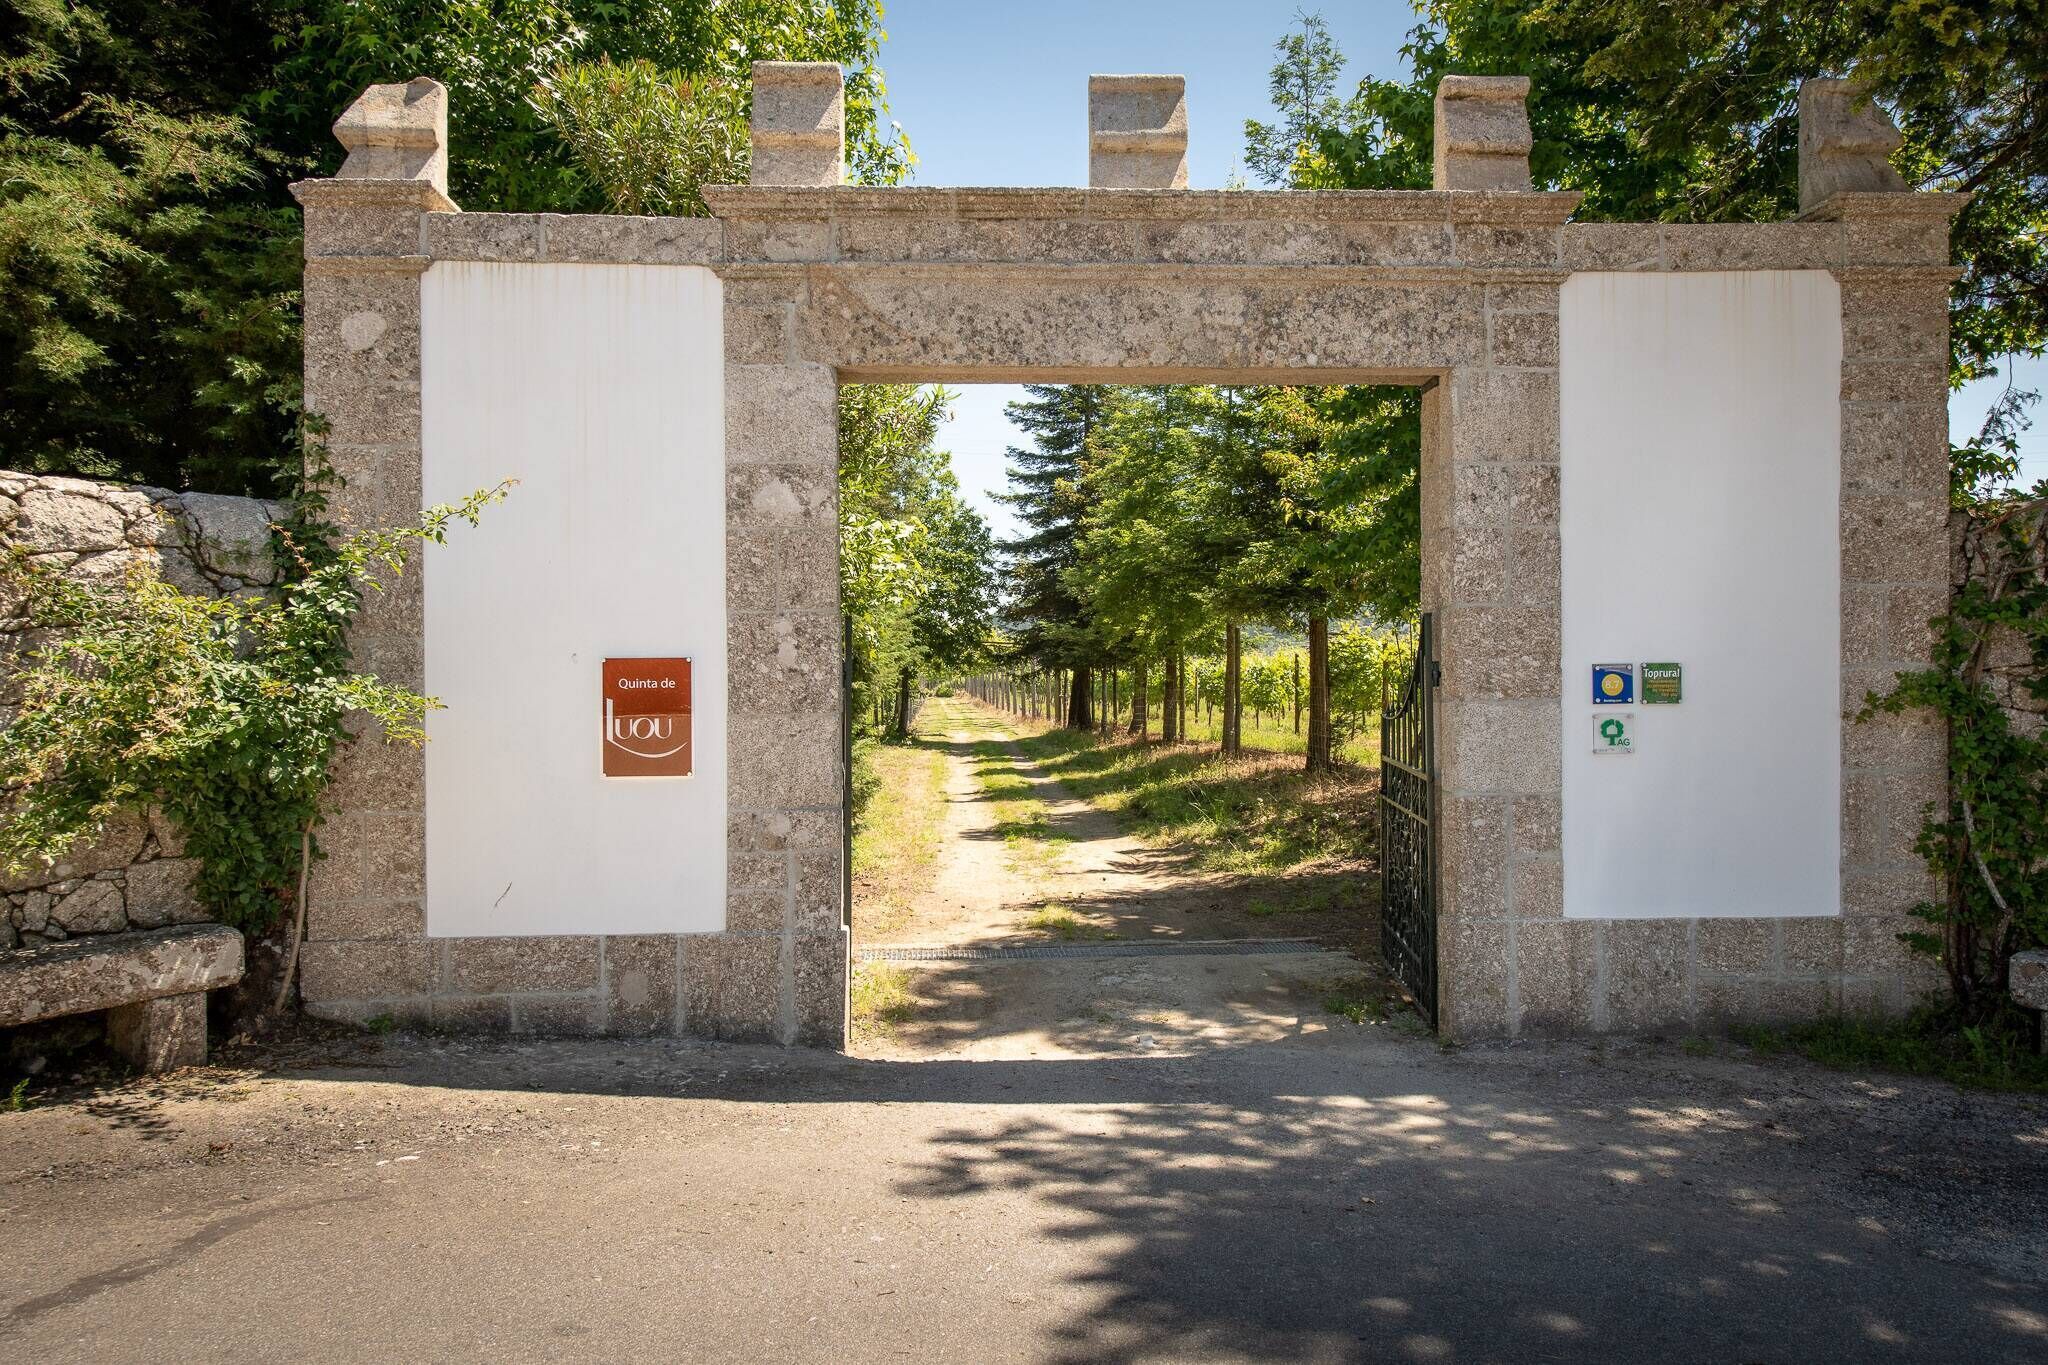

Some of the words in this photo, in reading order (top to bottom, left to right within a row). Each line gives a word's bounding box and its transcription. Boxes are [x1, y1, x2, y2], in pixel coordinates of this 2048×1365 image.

[1643, 668, 1680, 679] Toprural
[618, 678, 657, 689] Quinta
[660, 677, 676, 689] de
[1616, 738, 1631, 746] AG
